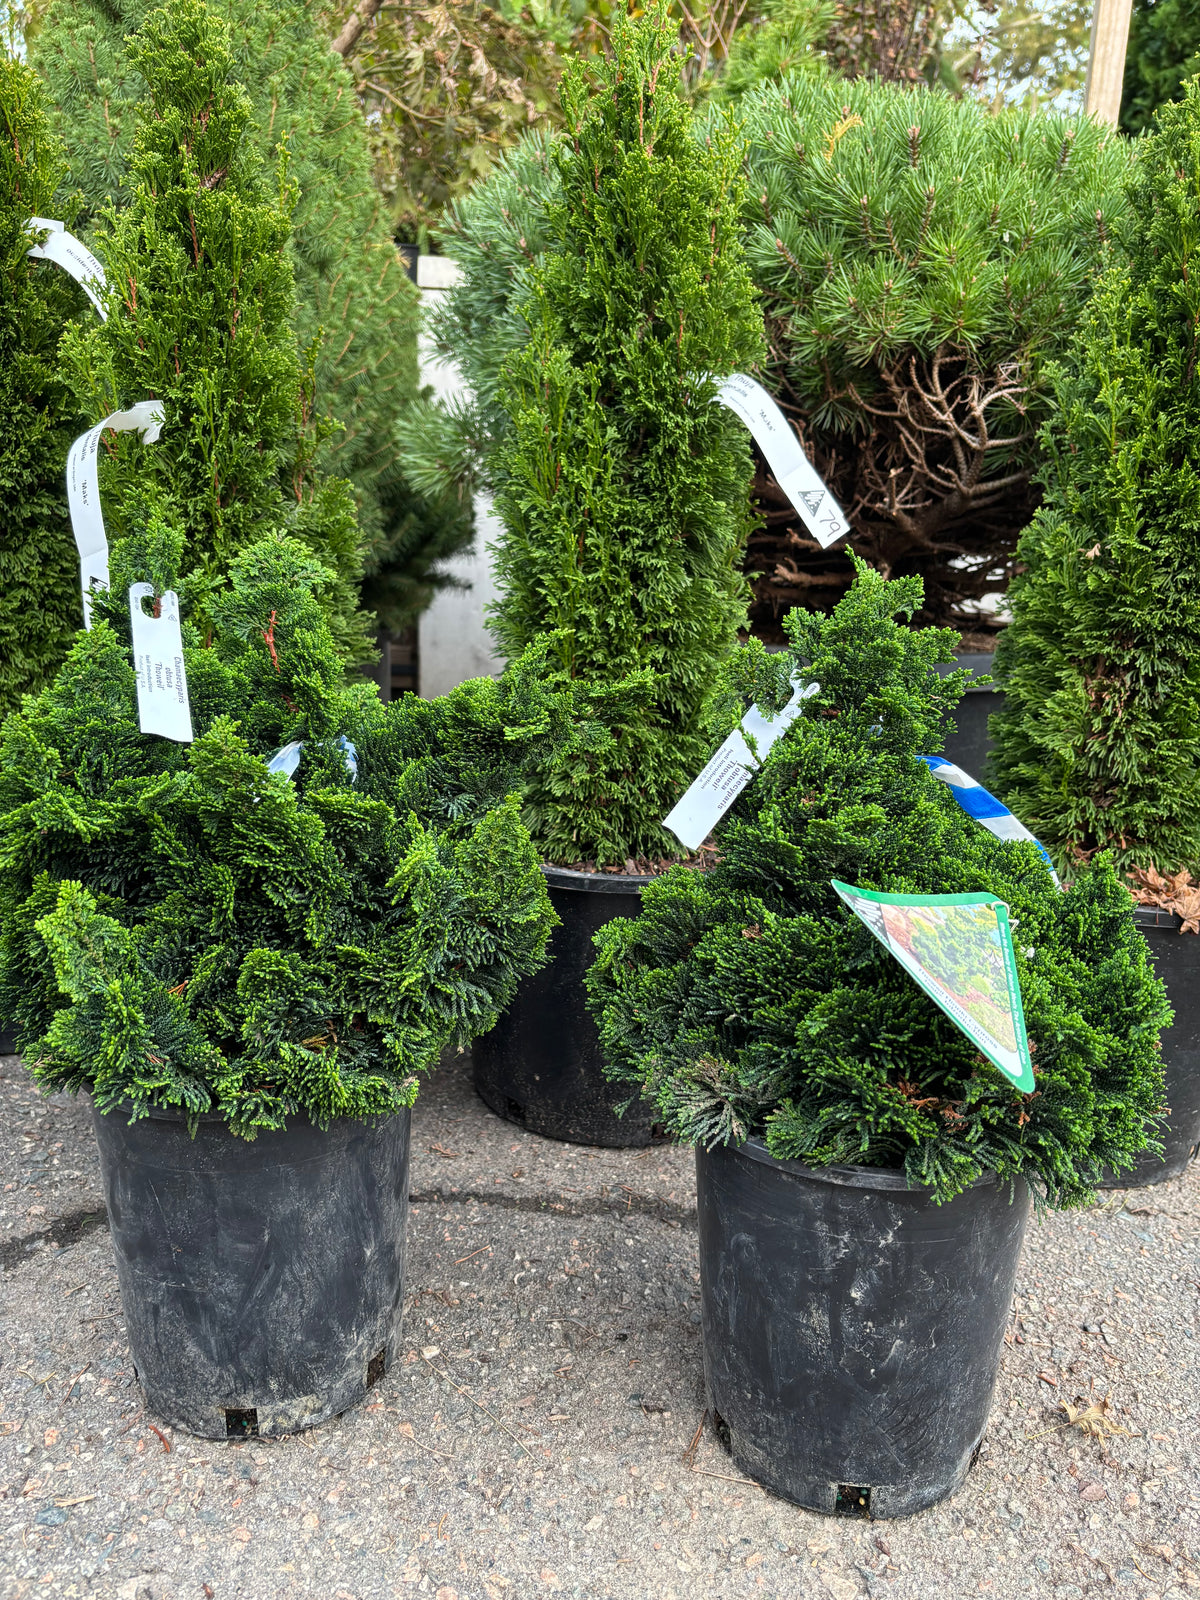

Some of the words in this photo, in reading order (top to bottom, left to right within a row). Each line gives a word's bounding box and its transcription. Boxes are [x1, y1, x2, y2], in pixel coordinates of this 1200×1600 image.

[820, 509, 841, 538] 79
[165, 667, 173, 688] obtusa
[173, 656, 184, 704] Chamaecyparis
[701, 759, 725, 790] Introduction
[713, 760, 738, 791] 'Thoweil'
[720, 767, 741, 791] obtusa
